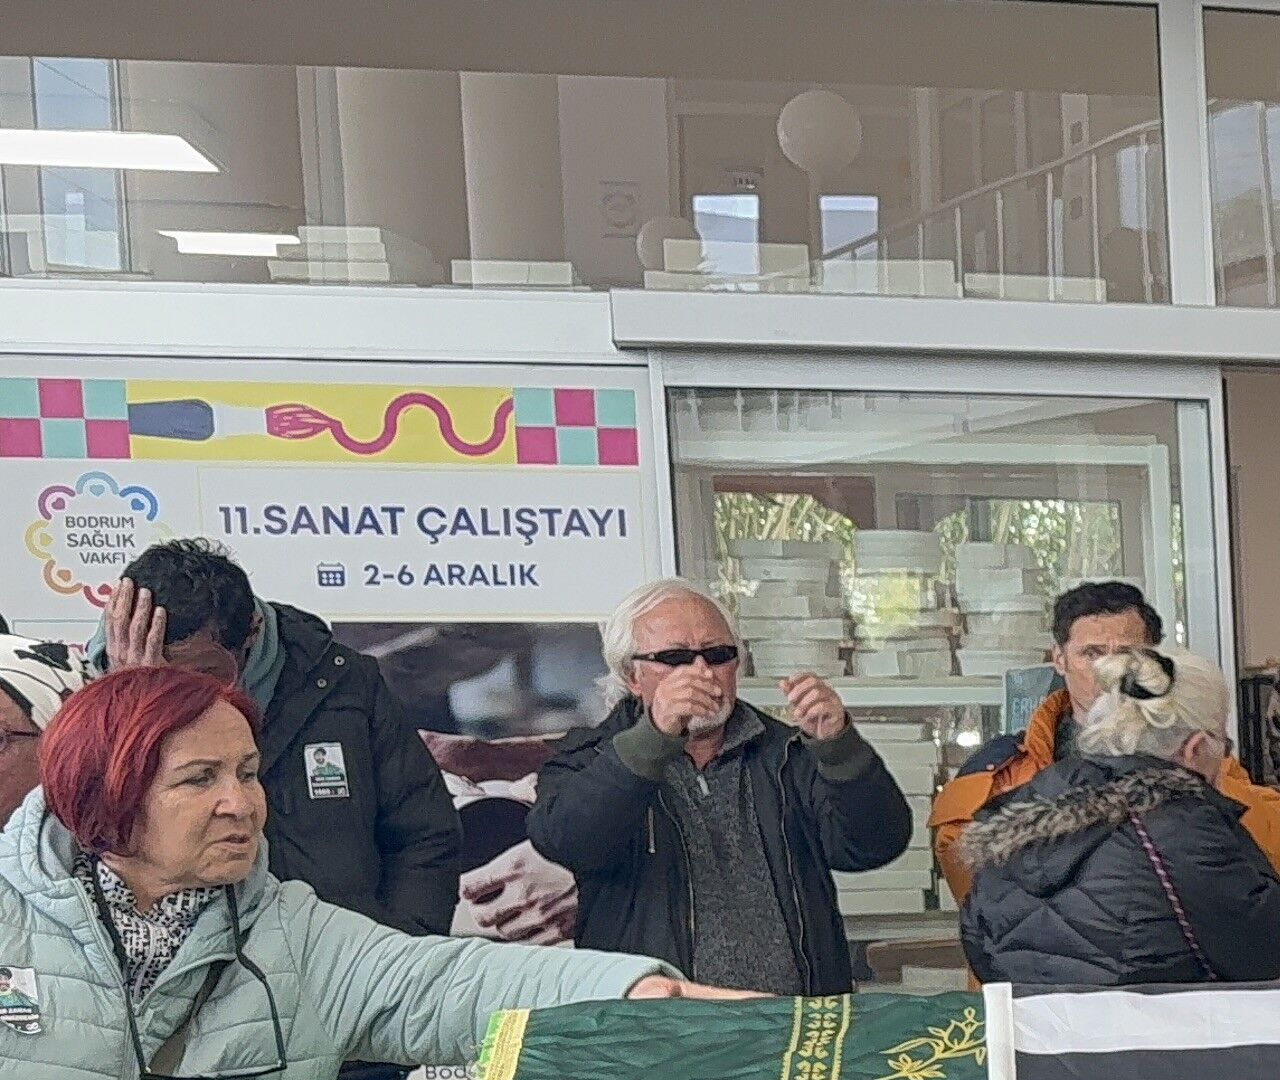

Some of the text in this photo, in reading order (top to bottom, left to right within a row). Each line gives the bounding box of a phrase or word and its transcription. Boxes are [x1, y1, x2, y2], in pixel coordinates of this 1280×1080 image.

[65, 516, 135, 529] BODRUM
[218, 506, 627, 546] 11.SANAT ÇALIŞTAYI
[66, 530, 135, 548] SAĞLIK
[80, 552, 126, 564] VAKFI
[364, 564, 540, 587] 2-6 ARALIK
